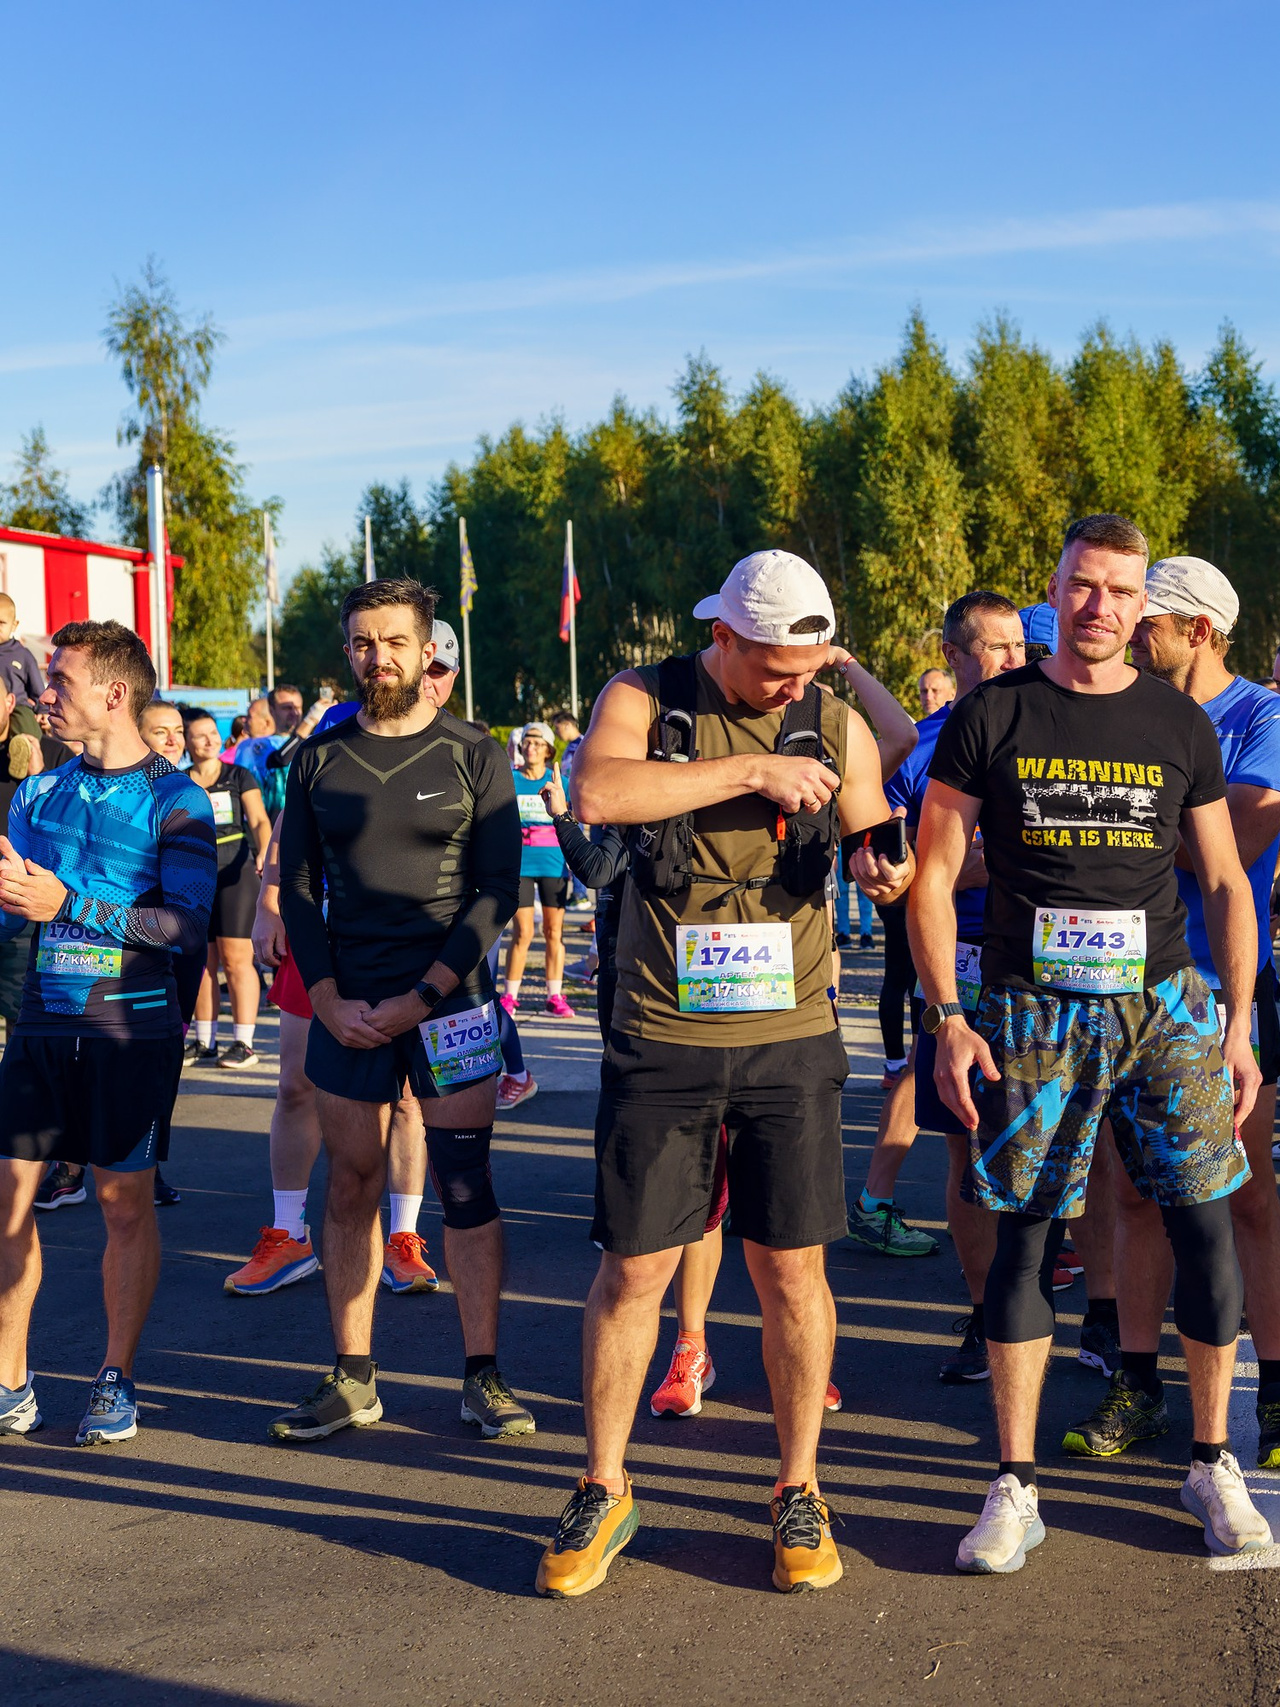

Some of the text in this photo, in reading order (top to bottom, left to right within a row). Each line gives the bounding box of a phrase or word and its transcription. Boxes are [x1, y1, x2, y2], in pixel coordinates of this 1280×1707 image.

[1016, 757, 1164, 787] WARNING
[1021, 829, 1163, 850] CSKA IS HERE...
[1056, 930, 1126, 950] 1743
[54, 952, 66, 964] 17
[700, 945, 772, 966] 1744
[1071, 955, 1112, 963] СЕРГЕЙ
[1066, 964, 1115, 981] 17 КМ
[712, 982, 764, 998] 17 КМ
[443, 1020, 493, 1049] 1705
[459, 1057, 474, 1070] 17
